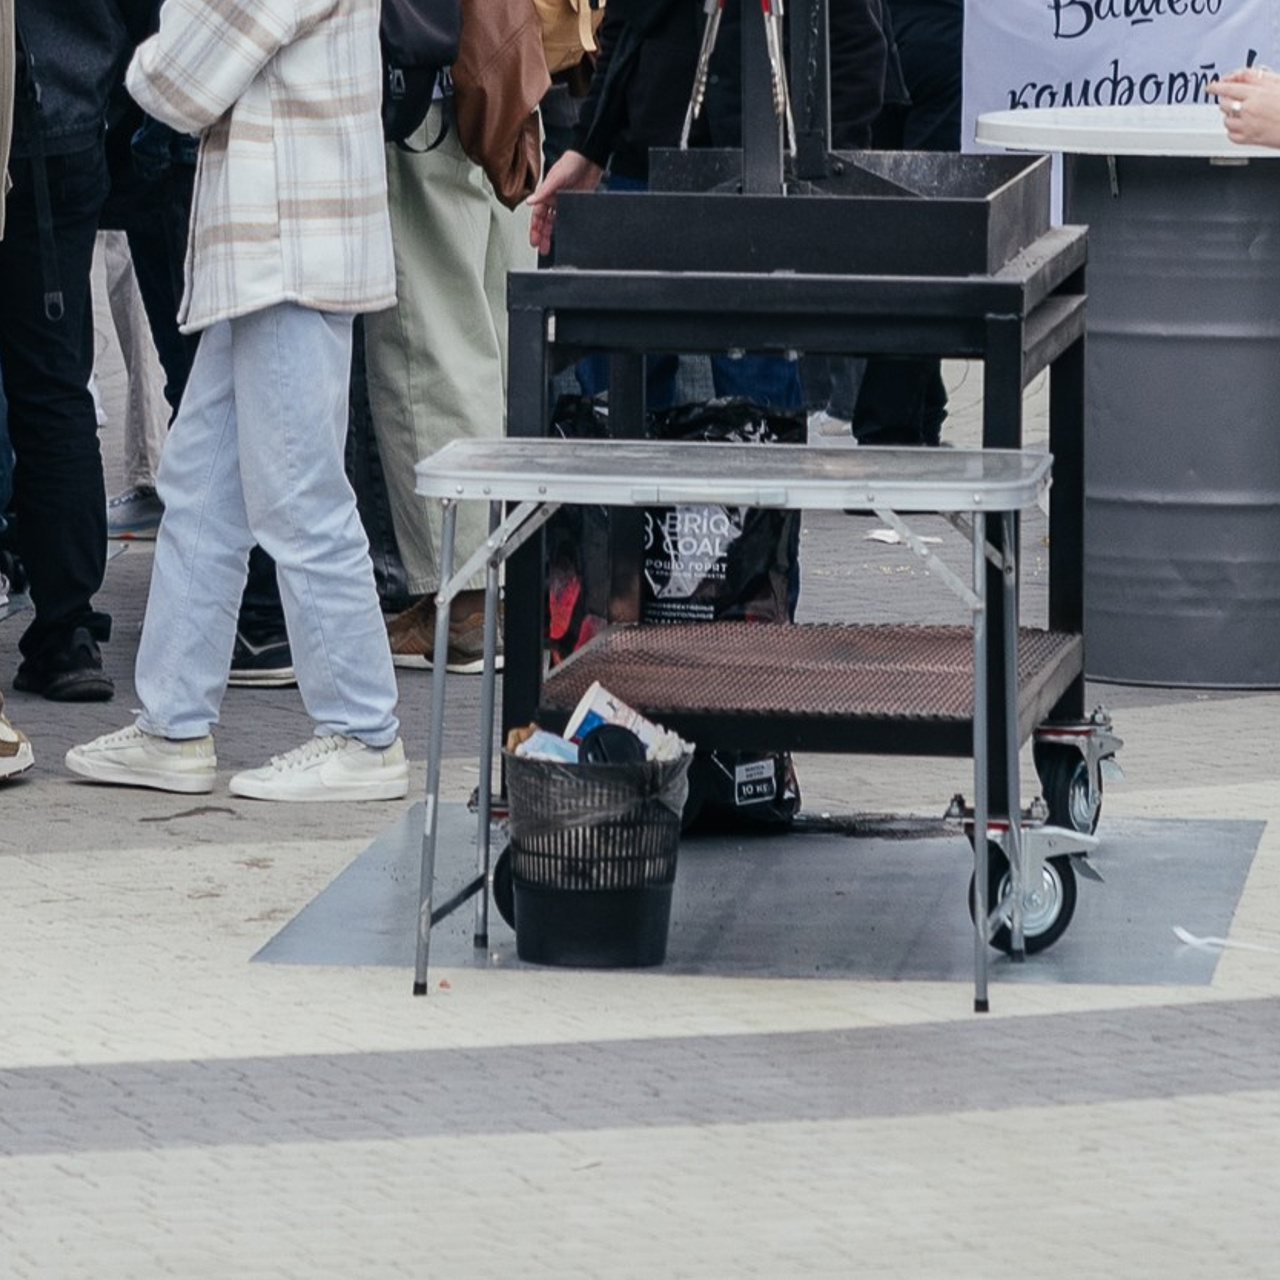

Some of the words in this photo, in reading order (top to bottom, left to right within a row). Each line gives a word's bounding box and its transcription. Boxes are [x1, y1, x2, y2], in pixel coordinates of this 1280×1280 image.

[1008, 48, 1257, 109] комфорт
[663, 537, 727, 558] COAL
[645, 559, 685, 570] РОШО
[742, 784, 753, 796] 10
